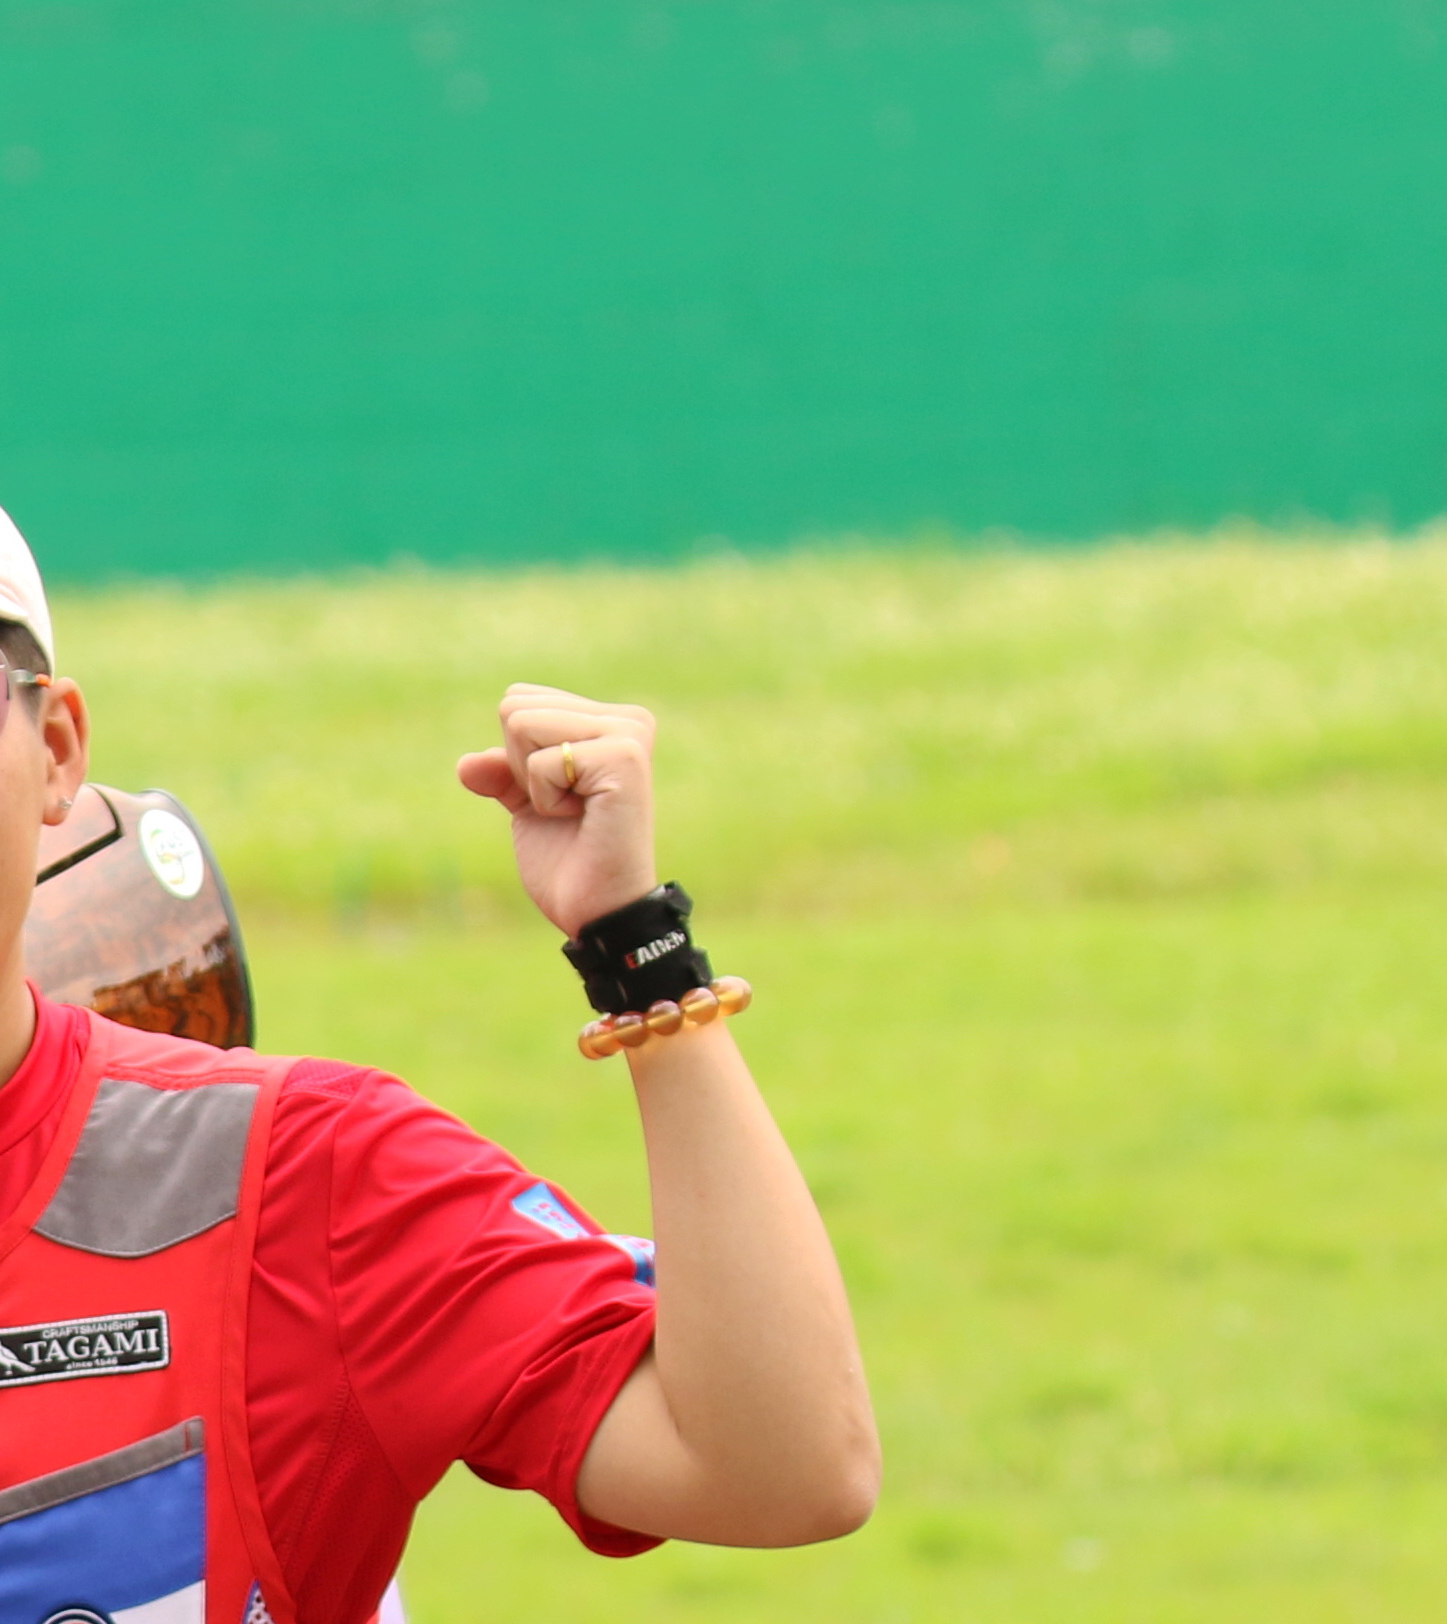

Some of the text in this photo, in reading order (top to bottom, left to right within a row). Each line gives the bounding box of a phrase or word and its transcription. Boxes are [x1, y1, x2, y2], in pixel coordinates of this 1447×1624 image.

[42, 1319, 140, 1340] CRAFTSMANSHIP
[23, 1328, 161, 1365] TAGAMI
[66, 1359, 94, 1371] since
